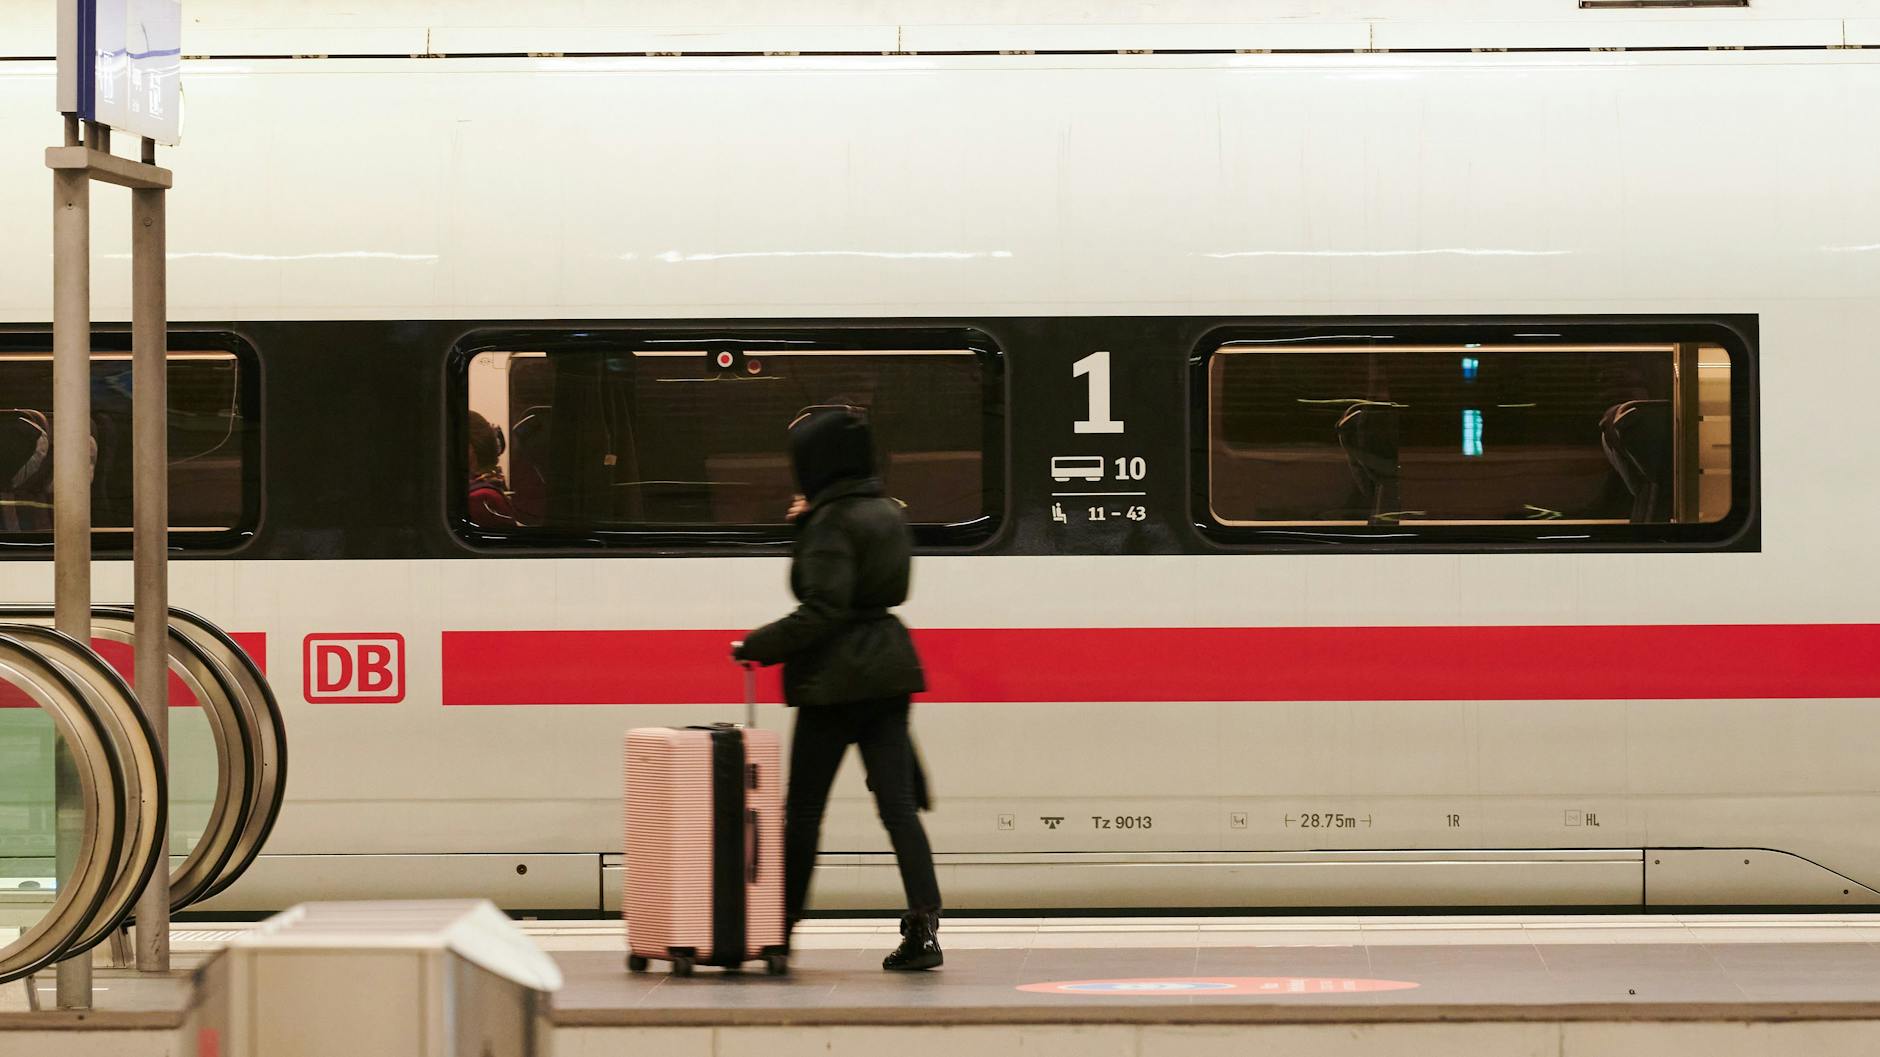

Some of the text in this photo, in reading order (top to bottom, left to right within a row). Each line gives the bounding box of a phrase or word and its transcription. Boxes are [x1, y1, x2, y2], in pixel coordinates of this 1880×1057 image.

[1073, 352, 1124, 433] 1
[1115, 457, 1146, 480] 10
[1088, 507, 1106, 521] 11
[1126, 506, 1146, 521] 43
[316, 645, 393, 692] DB
[1091, 816, 1152, 829] Tz 9013
[1300, 813, 1356, 828] 28.75m
[1446, 814, 1460, 827] 1R
